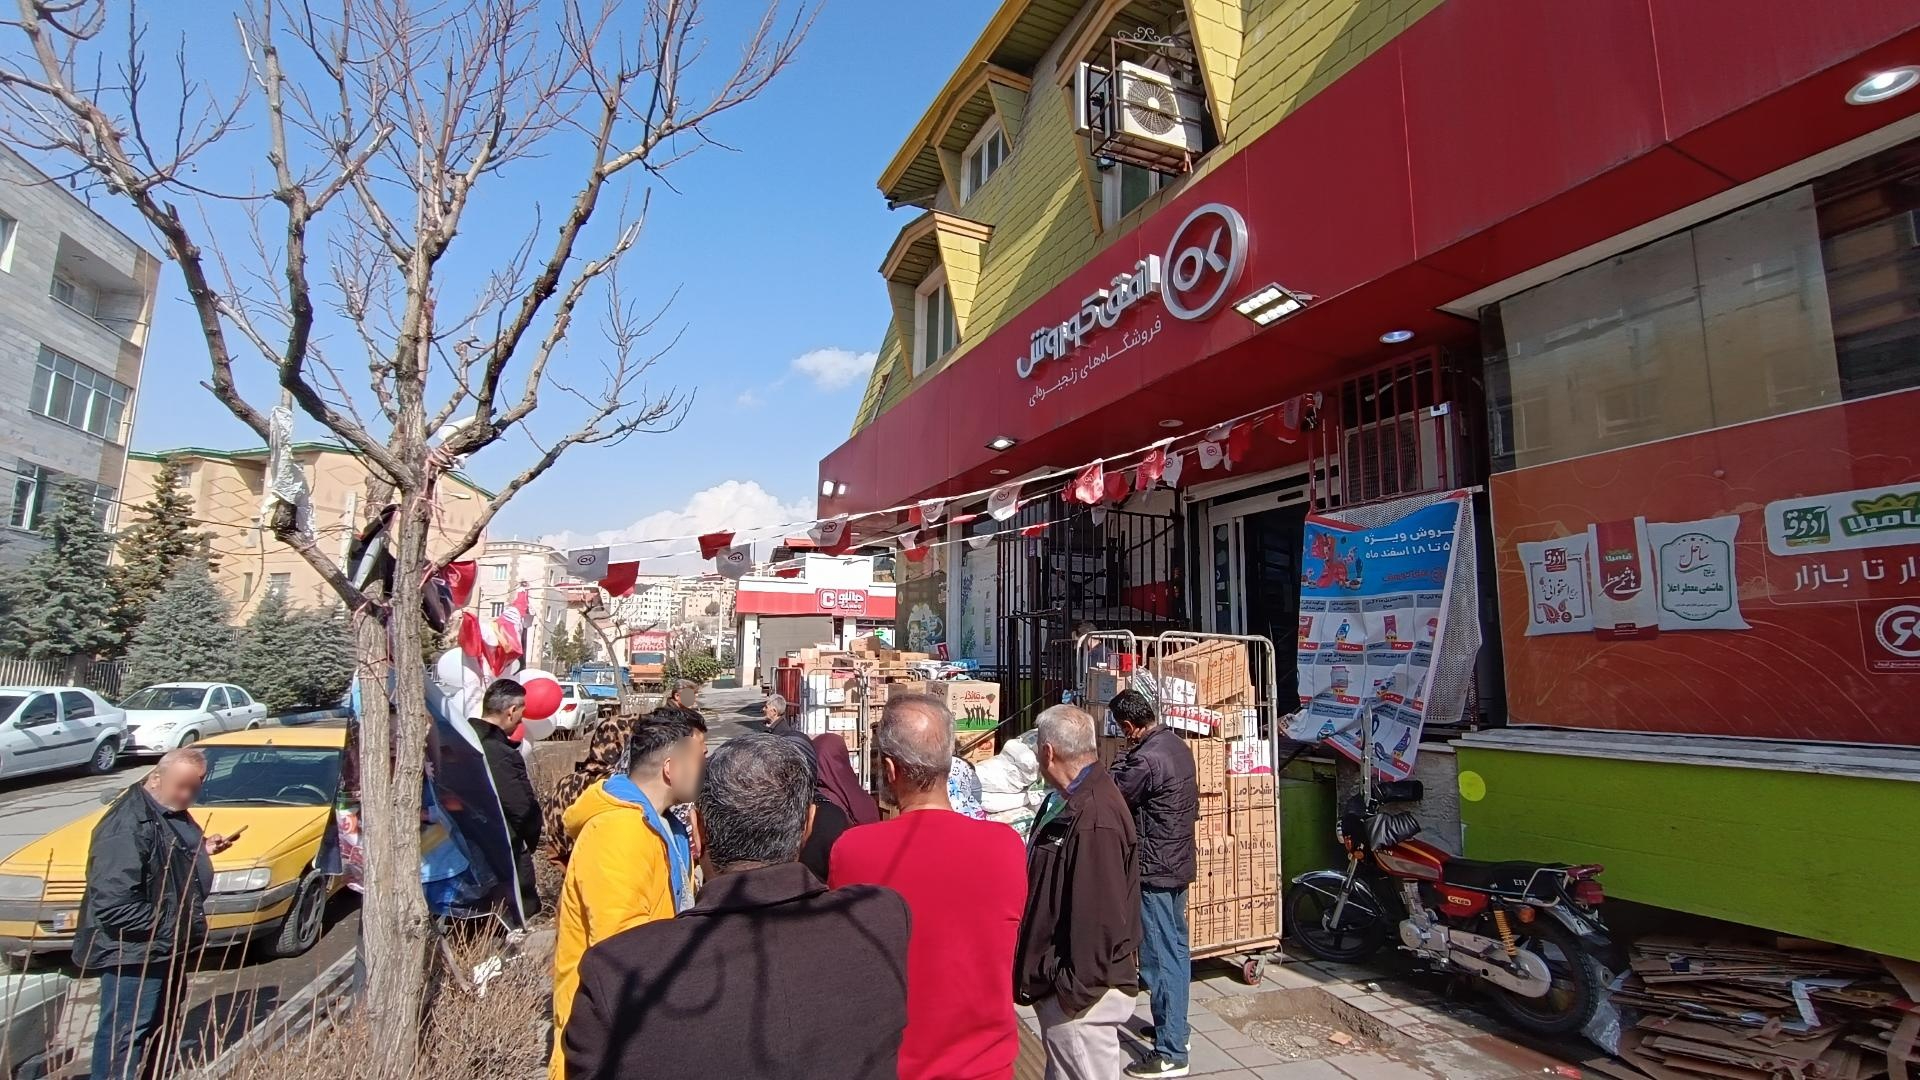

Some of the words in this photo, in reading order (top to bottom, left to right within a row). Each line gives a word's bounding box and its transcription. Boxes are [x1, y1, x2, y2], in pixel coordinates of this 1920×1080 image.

[1097, 254, 1162, 328] افق
[1016, 288, 1110, 380] کوروش
[1364, 531, 1408, 546] ویژه
[1365, 549, 1379, 559] ماه
[1380, 546, 1410, 558] اسفند
[1411, 545, 1426, 554] ۱۸
[1427, 542, 1441, 552] تا
[1793, 563, 1849, 592] بازار
[1861, 559, 1886, 581] تا
